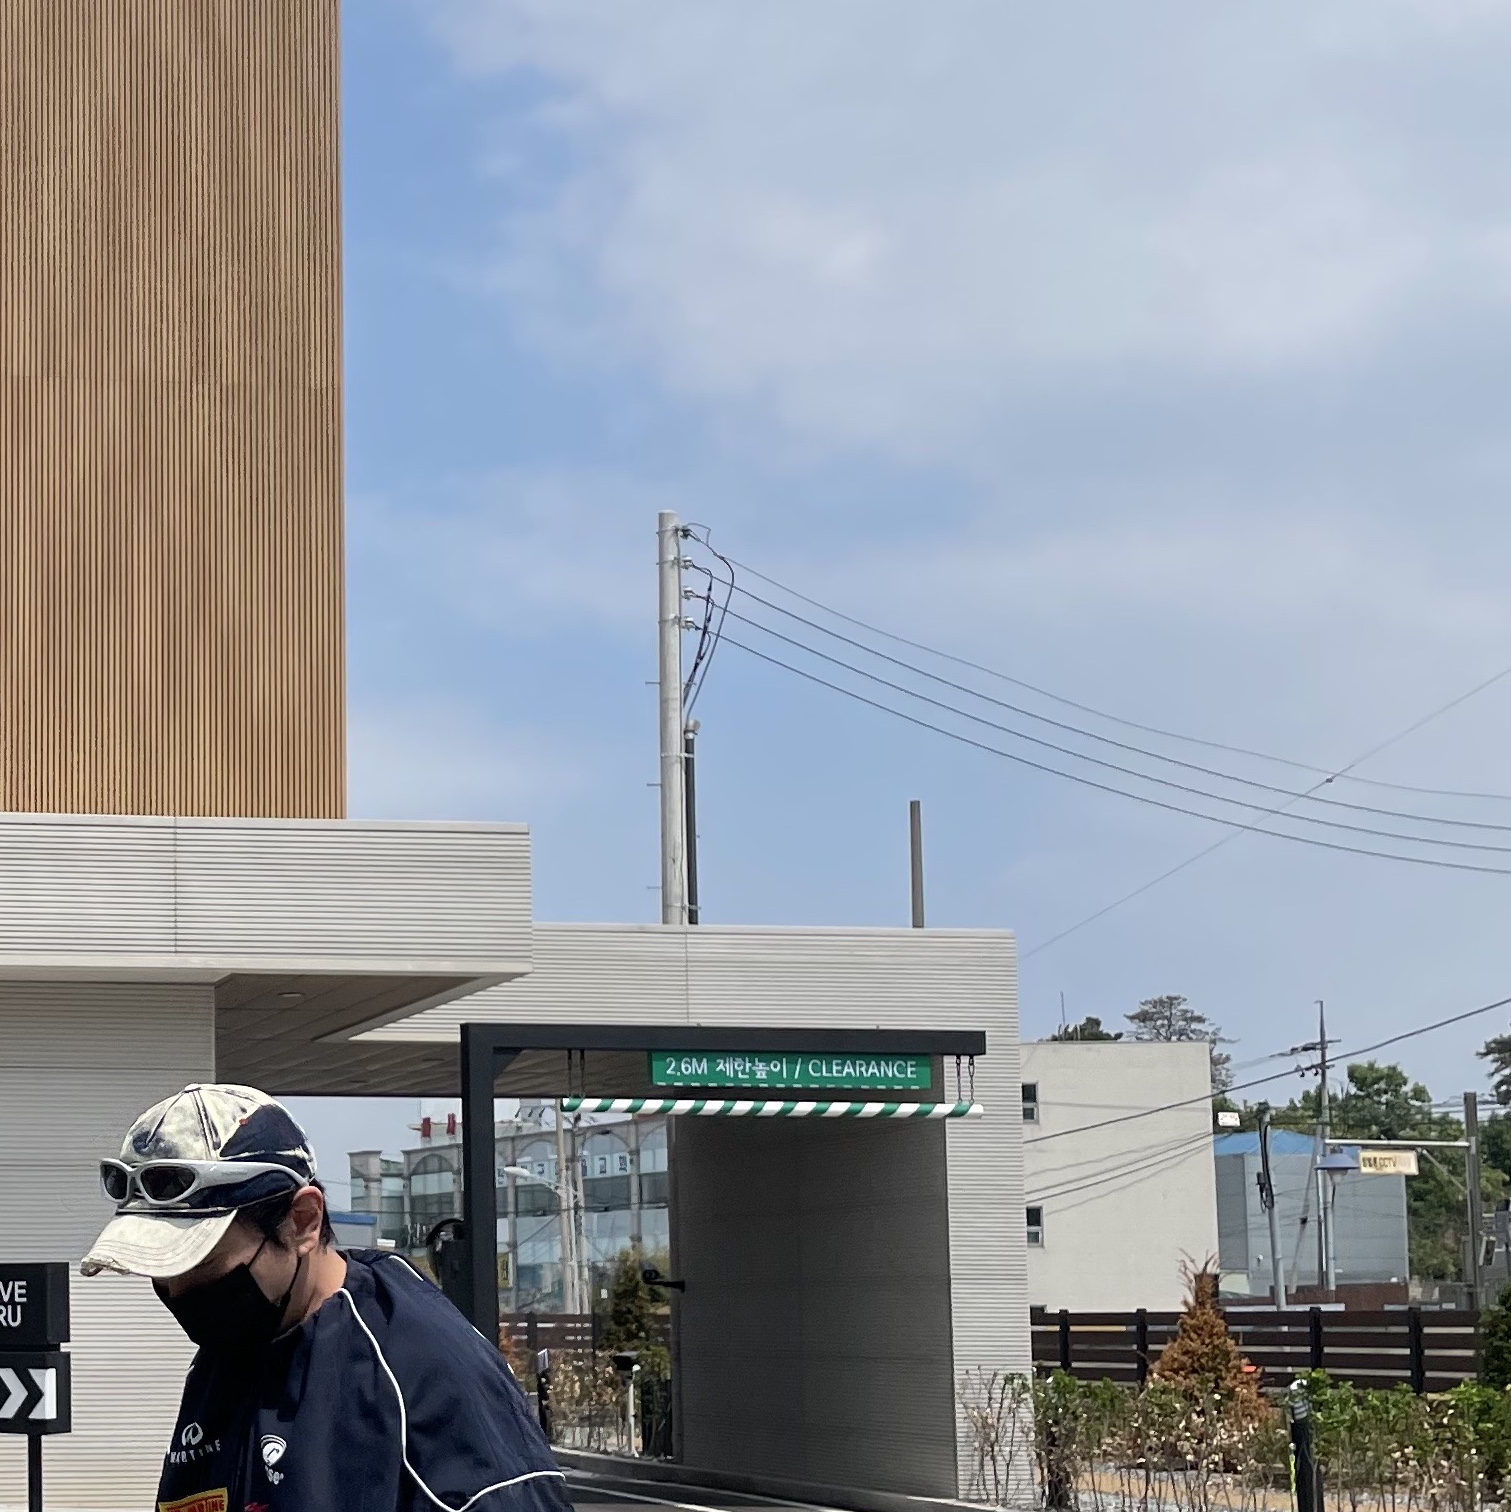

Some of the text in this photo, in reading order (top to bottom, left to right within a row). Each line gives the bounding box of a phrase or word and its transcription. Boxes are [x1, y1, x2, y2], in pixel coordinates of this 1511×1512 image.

[666, 1057, 917, 1080] 2.6M 제한높이 / CLEARANCE
